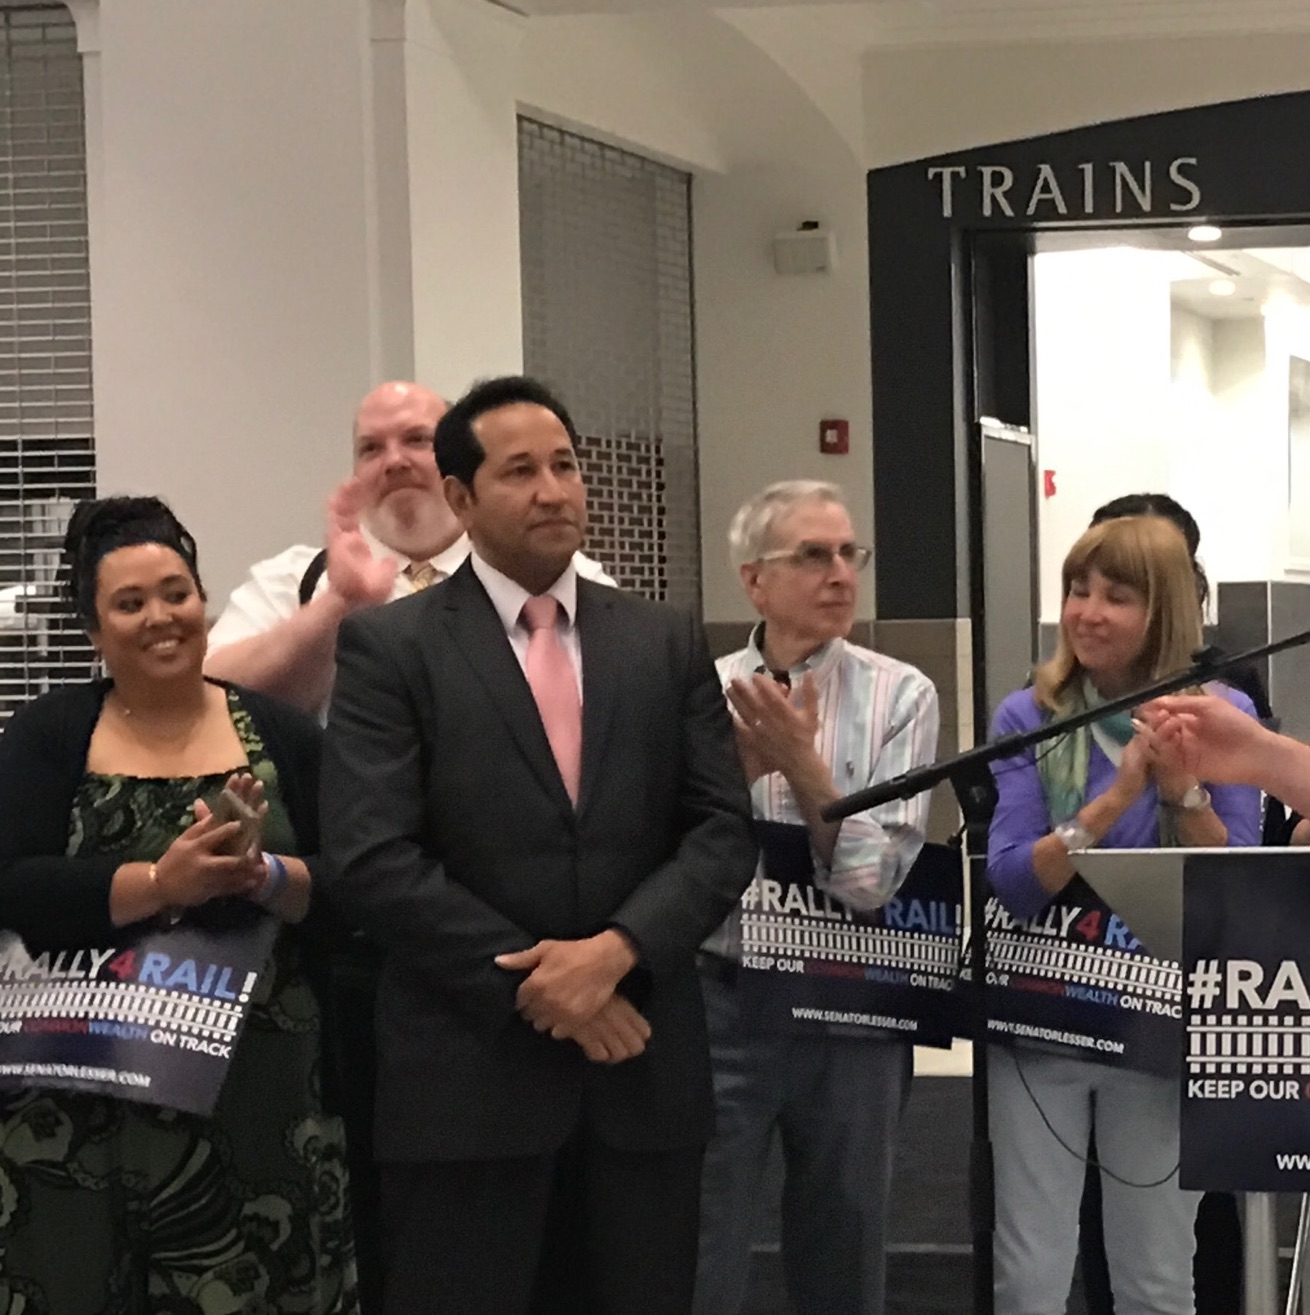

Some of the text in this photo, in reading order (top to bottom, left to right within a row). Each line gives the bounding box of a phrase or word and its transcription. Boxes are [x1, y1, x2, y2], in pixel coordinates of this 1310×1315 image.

[927, 156, 1202, 219] TRAINS
[885, 896, 962, 936] RAIL!
[138, 951, 257, 1003] RAIL!
[742, 954, 775, 972] KEEP
[776, 958, 804, 974] OUR
[910, 972, 927, 988] ON
[928, 975, 953, 992] TRAC
[1120, 994, 1143, 1011] ON
[1146, 1000, 1183, 1019] TRAC
[150, 1029, 176, 1047] ON
[179, 1035, 232, 1059] TRACK
[1188, 1079, 1245, 1099] KEEP
[1249, 1080, 1299, 1100] OUR
